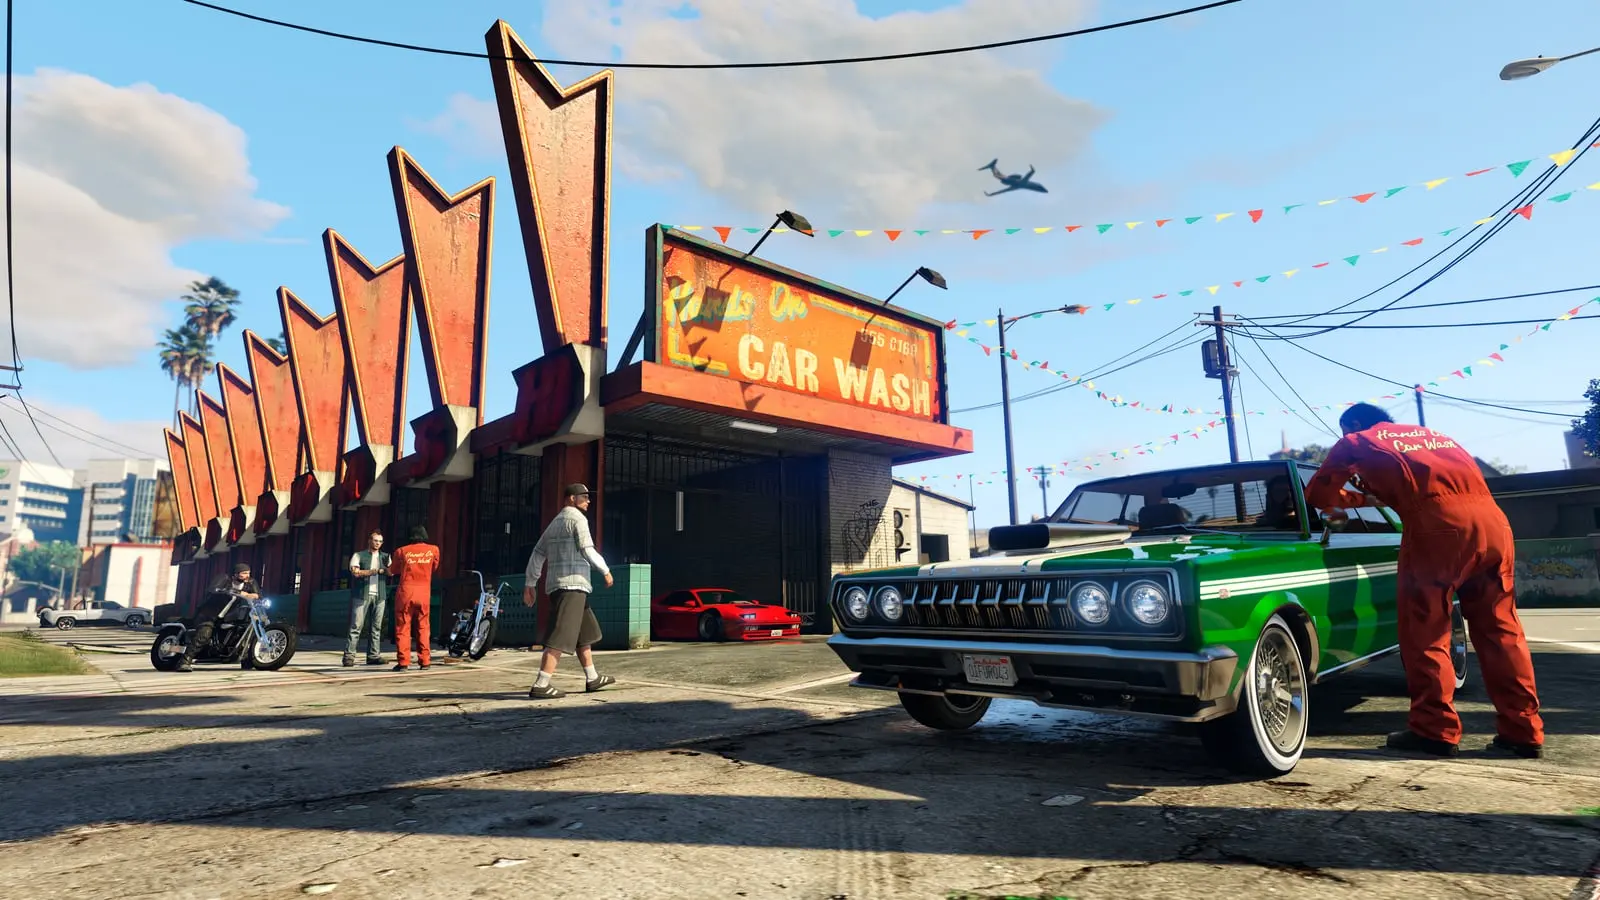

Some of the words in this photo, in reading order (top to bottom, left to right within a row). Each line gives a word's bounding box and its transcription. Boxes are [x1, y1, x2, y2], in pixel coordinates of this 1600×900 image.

[769, 281, 808, 322] On
[860, 327, 885, 348] 555
[738, 333, 819, 393] CAR
[834, 356, 931, 416] WASH
[1376, 429, 1426, 440] Hands
[1393, 440, 1422, 453] Car
[1424, 438, 1457, 450] Wash
